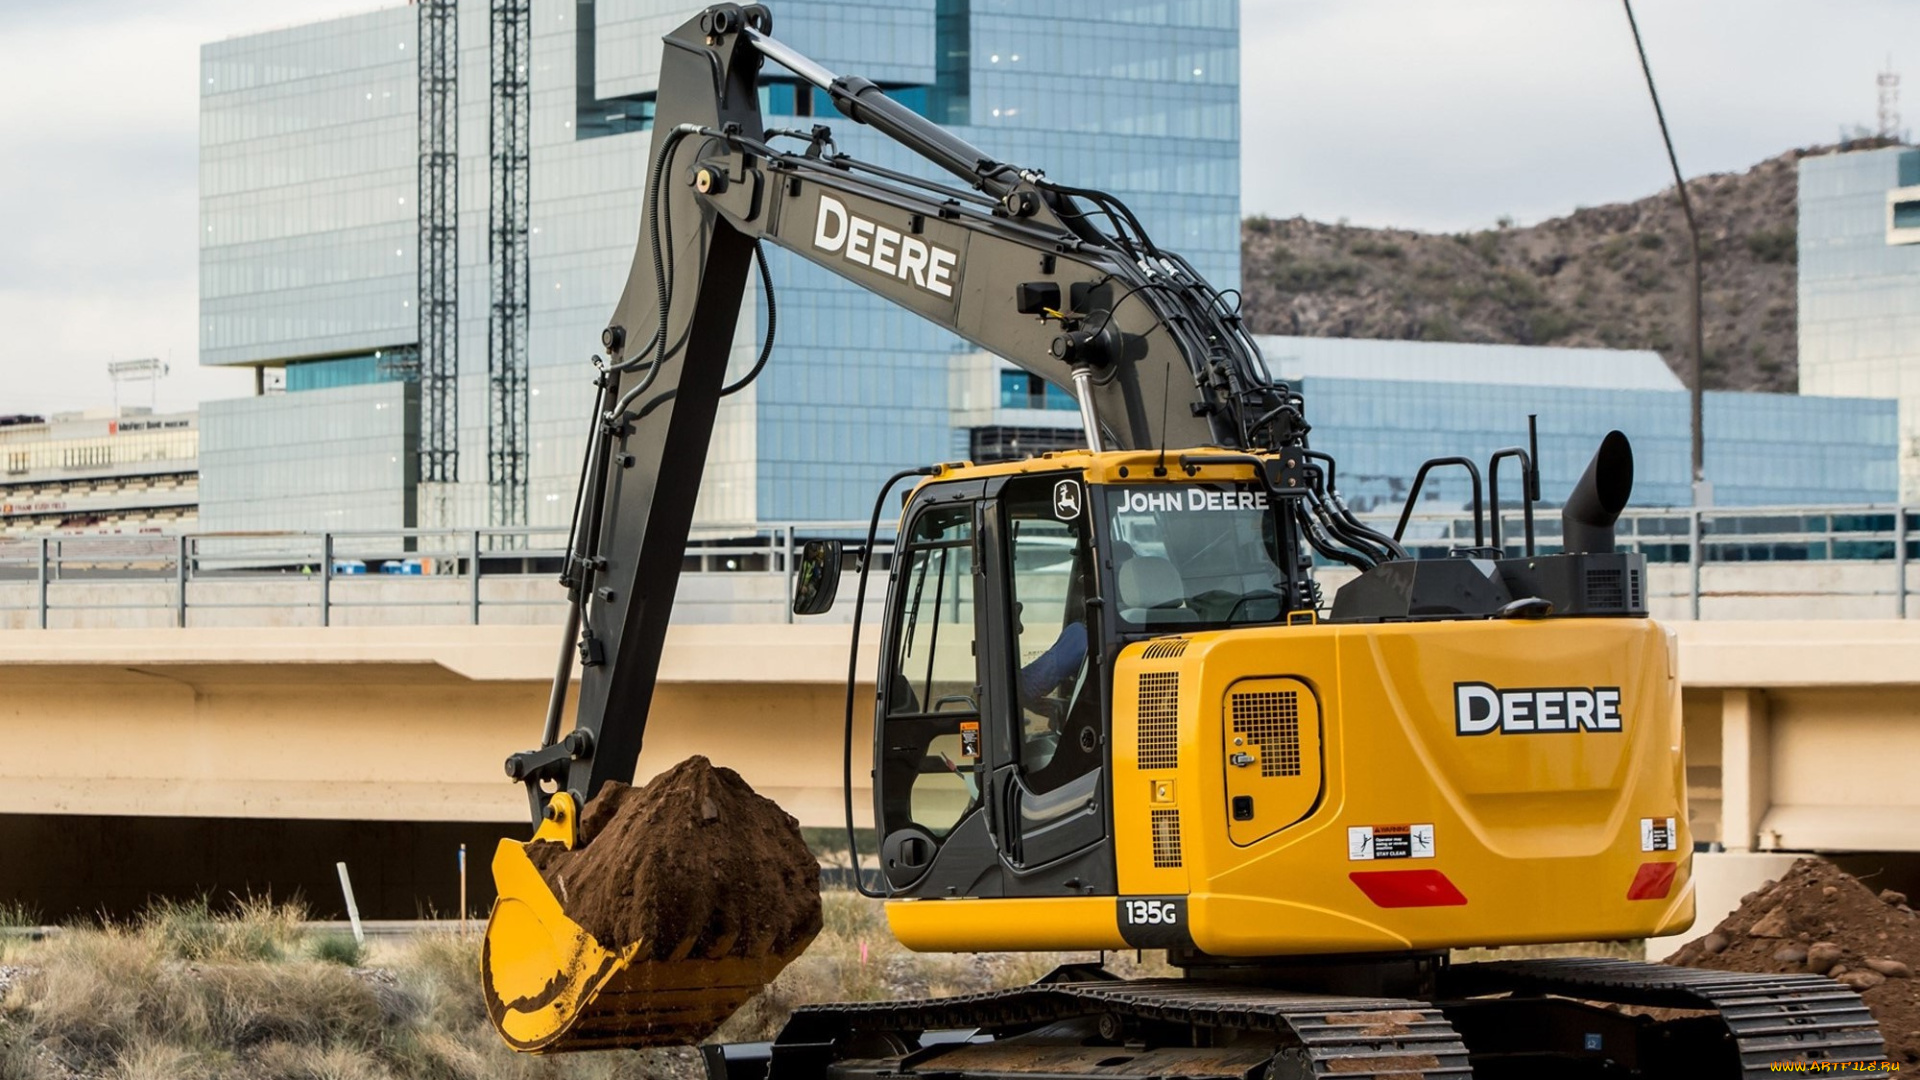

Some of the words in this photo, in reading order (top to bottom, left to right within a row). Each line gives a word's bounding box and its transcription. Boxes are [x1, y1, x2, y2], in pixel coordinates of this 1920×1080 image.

[815, 195, 957, 297] DEERE
[1117, 489, 1183, 513] JOHN
[1188, 488, 1270, 512] DEERE
[1456, 685, 1621, 733] DEERE
[1126, 900, 1176, 924] 135G
